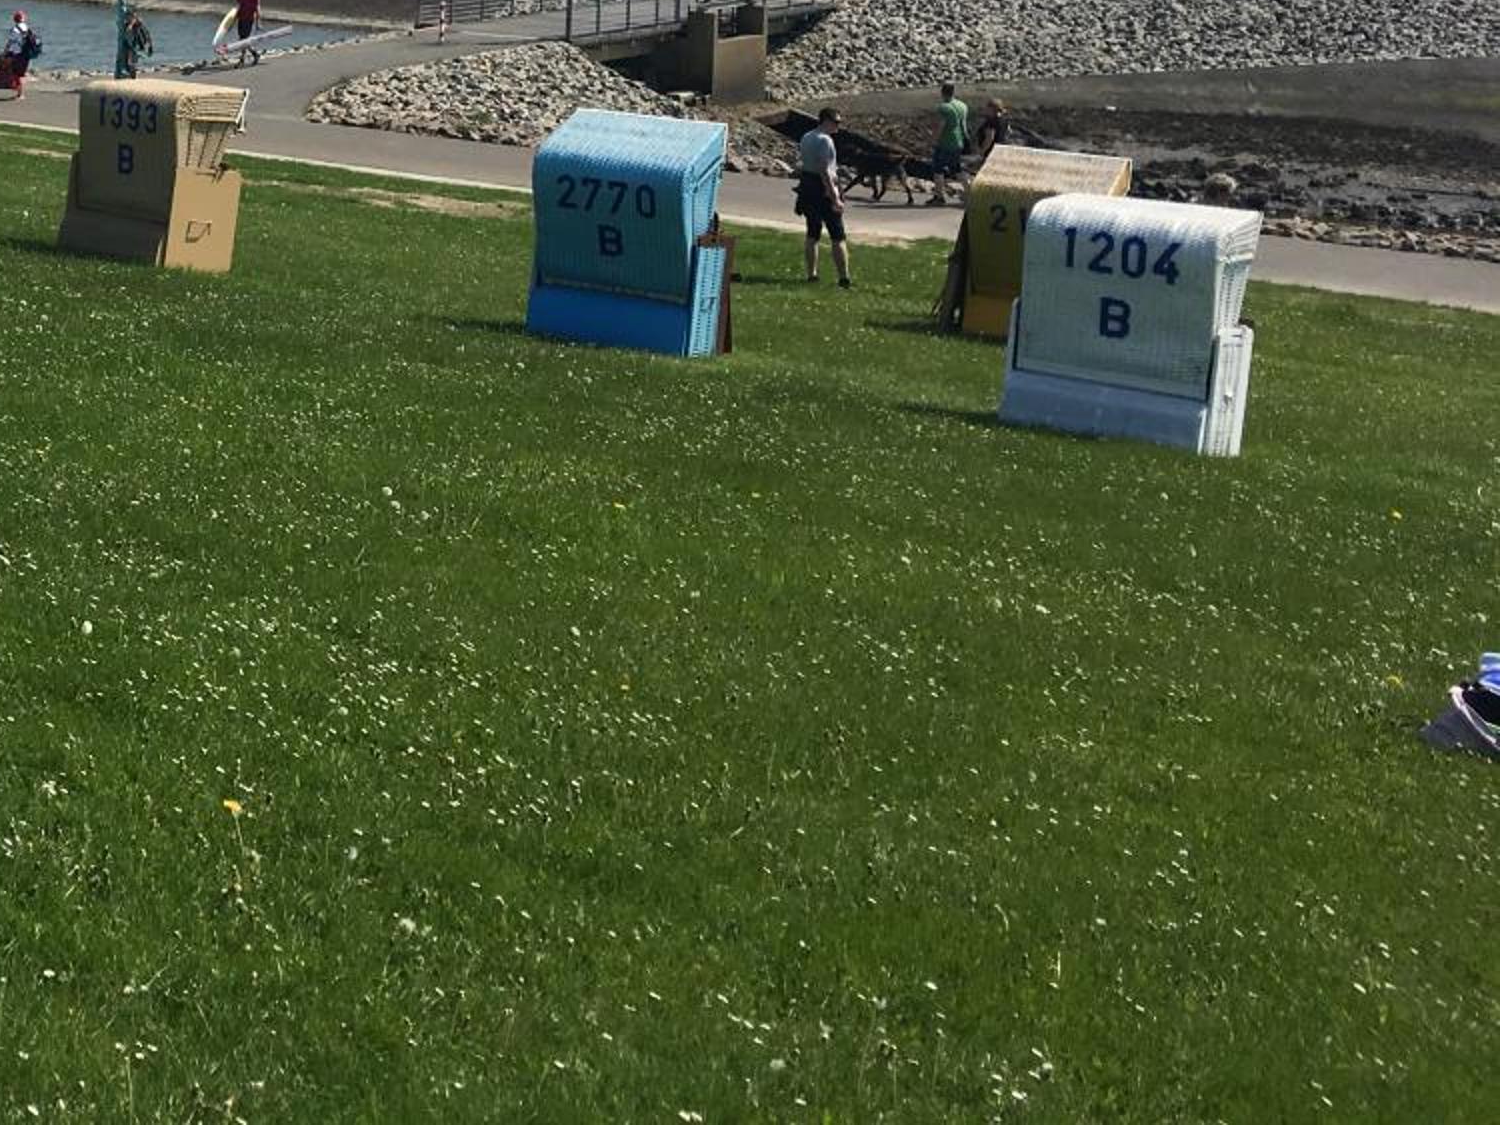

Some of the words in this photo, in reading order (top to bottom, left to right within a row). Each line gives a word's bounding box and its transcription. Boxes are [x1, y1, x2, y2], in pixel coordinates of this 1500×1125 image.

[100, 95, 158, 134] 1393
[117, 144, 133, 174] B
[557, 174, 656, 219] 2770
[598, 224, 623, 256] B
[1064, 227, 1183, 286] 1204
[1100, 296, 1131, 339] B
